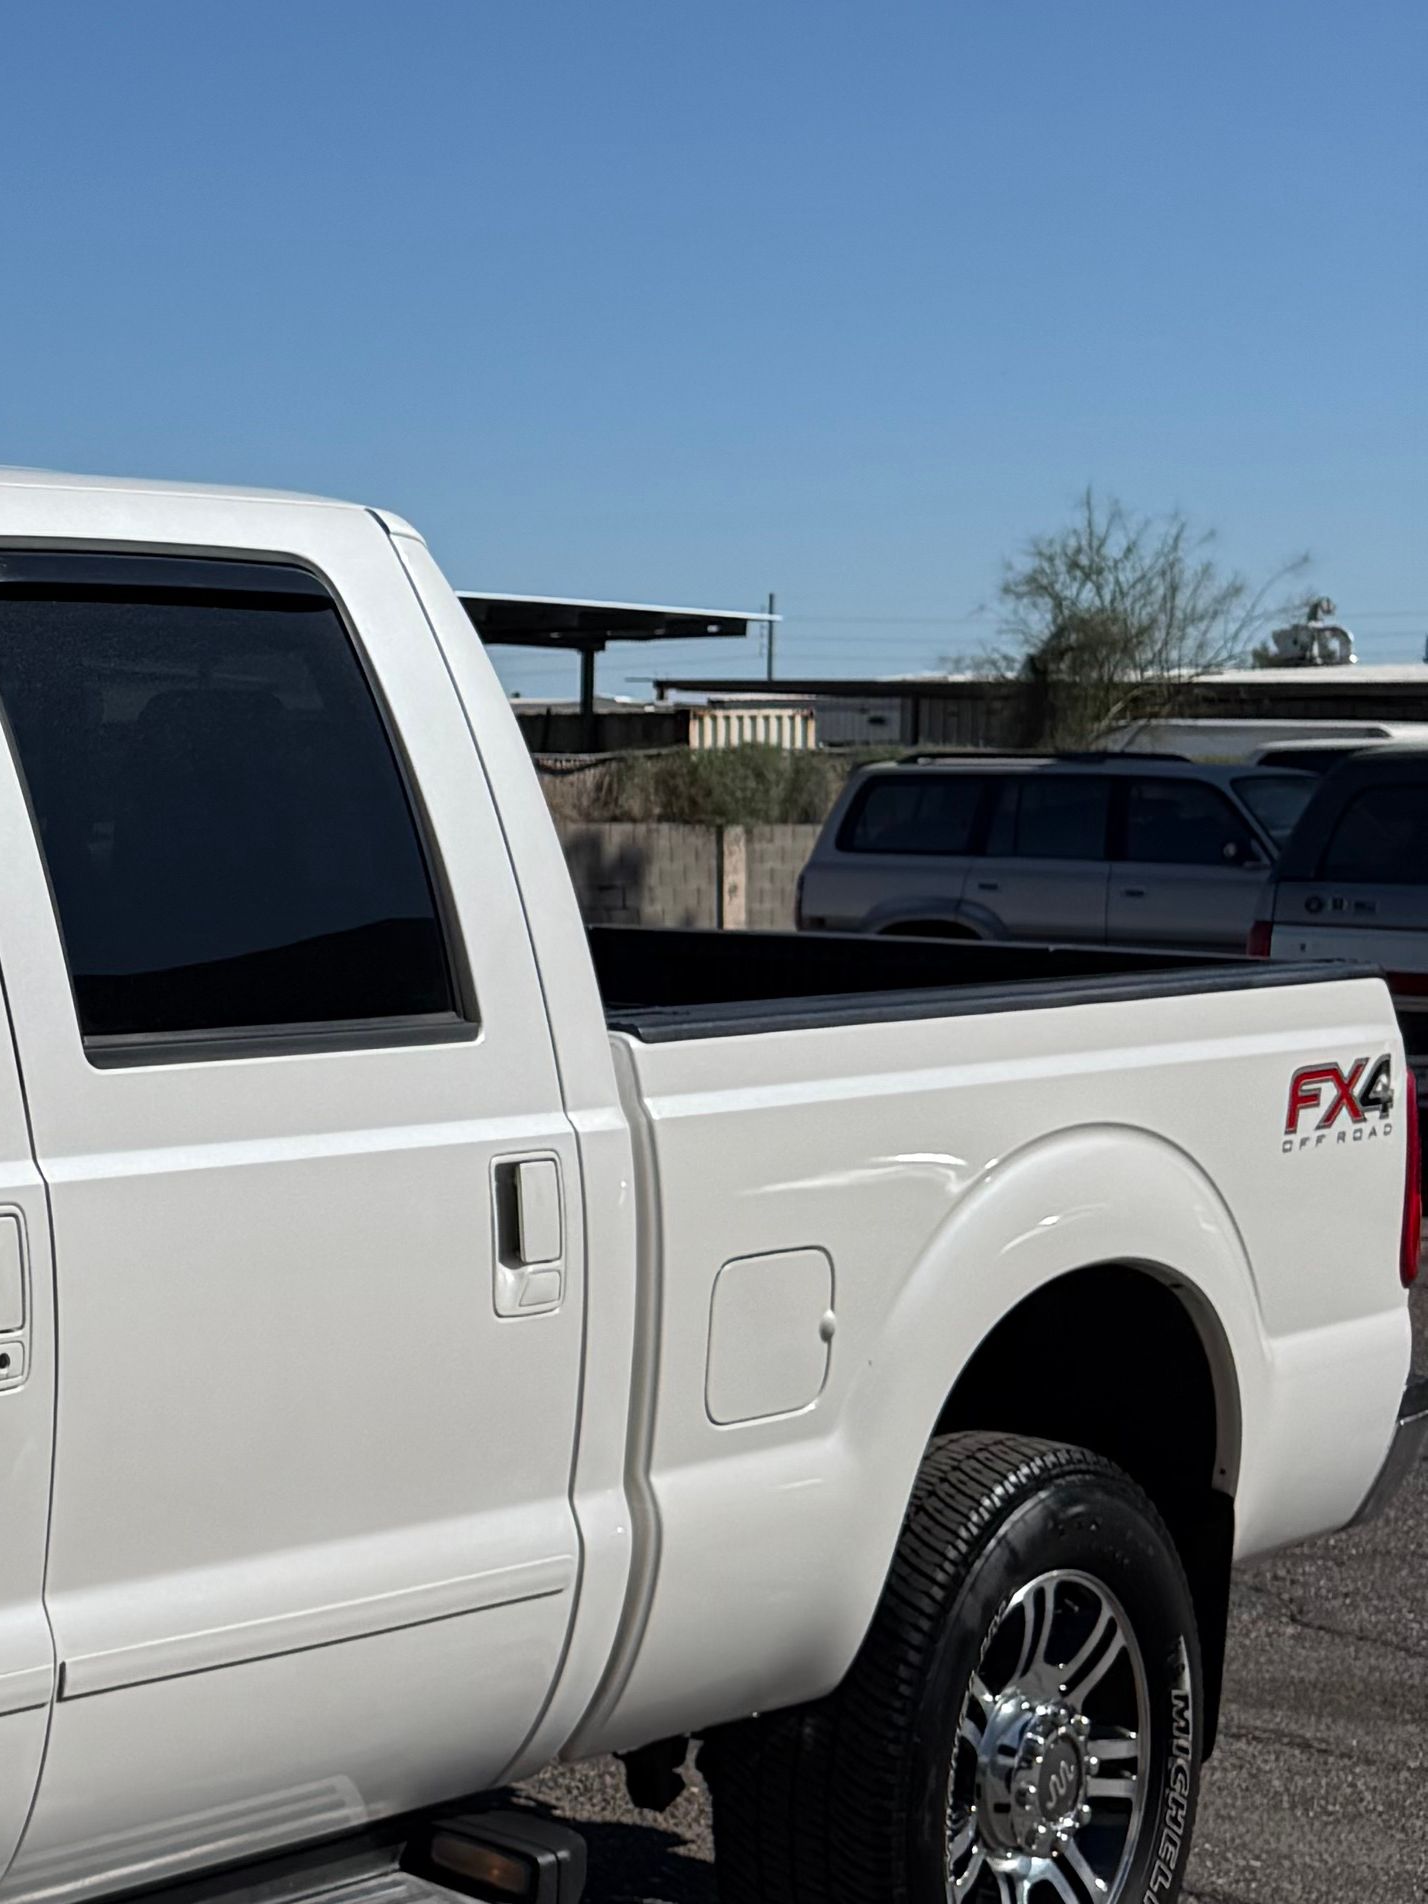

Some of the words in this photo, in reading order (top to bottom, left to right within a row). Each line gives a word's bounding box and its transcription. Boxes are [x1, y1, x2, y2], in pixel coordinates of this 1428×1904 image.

[1284, 1053, 1394, 1135] FX4
[1282, 1134, 1327, 1154] OFF
[1336, 1123, 1393, 1143] ROAD
